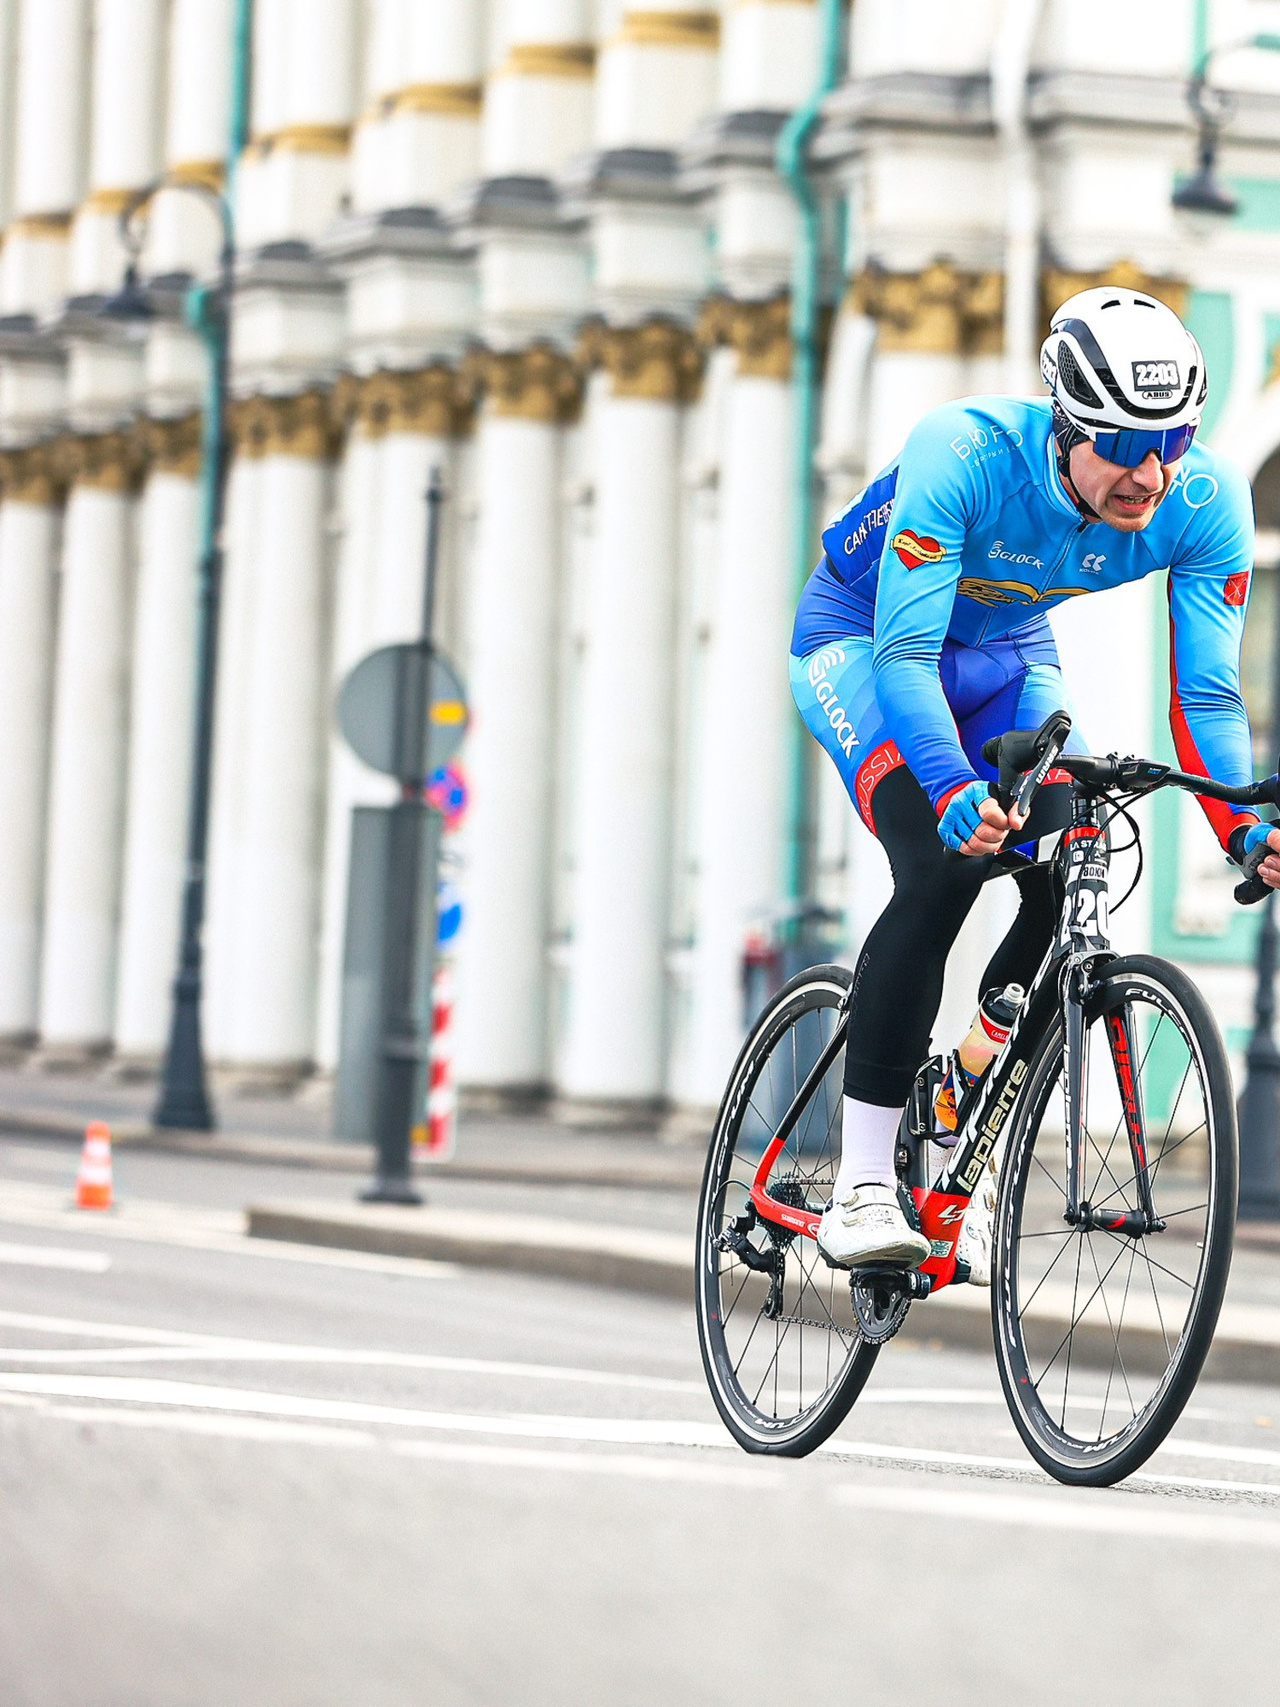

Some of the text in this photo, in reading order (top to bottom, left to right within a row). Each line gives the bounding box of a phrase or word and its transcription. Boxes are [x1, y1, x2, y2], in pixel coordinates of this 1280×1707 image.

[1136, 363, 1179, 387] 2203
[1000, 551, 1045, 570] GLOCK
[816, 681, 860, 760] GLOCK
[956, 1058, 1027, 1192] lapierre
